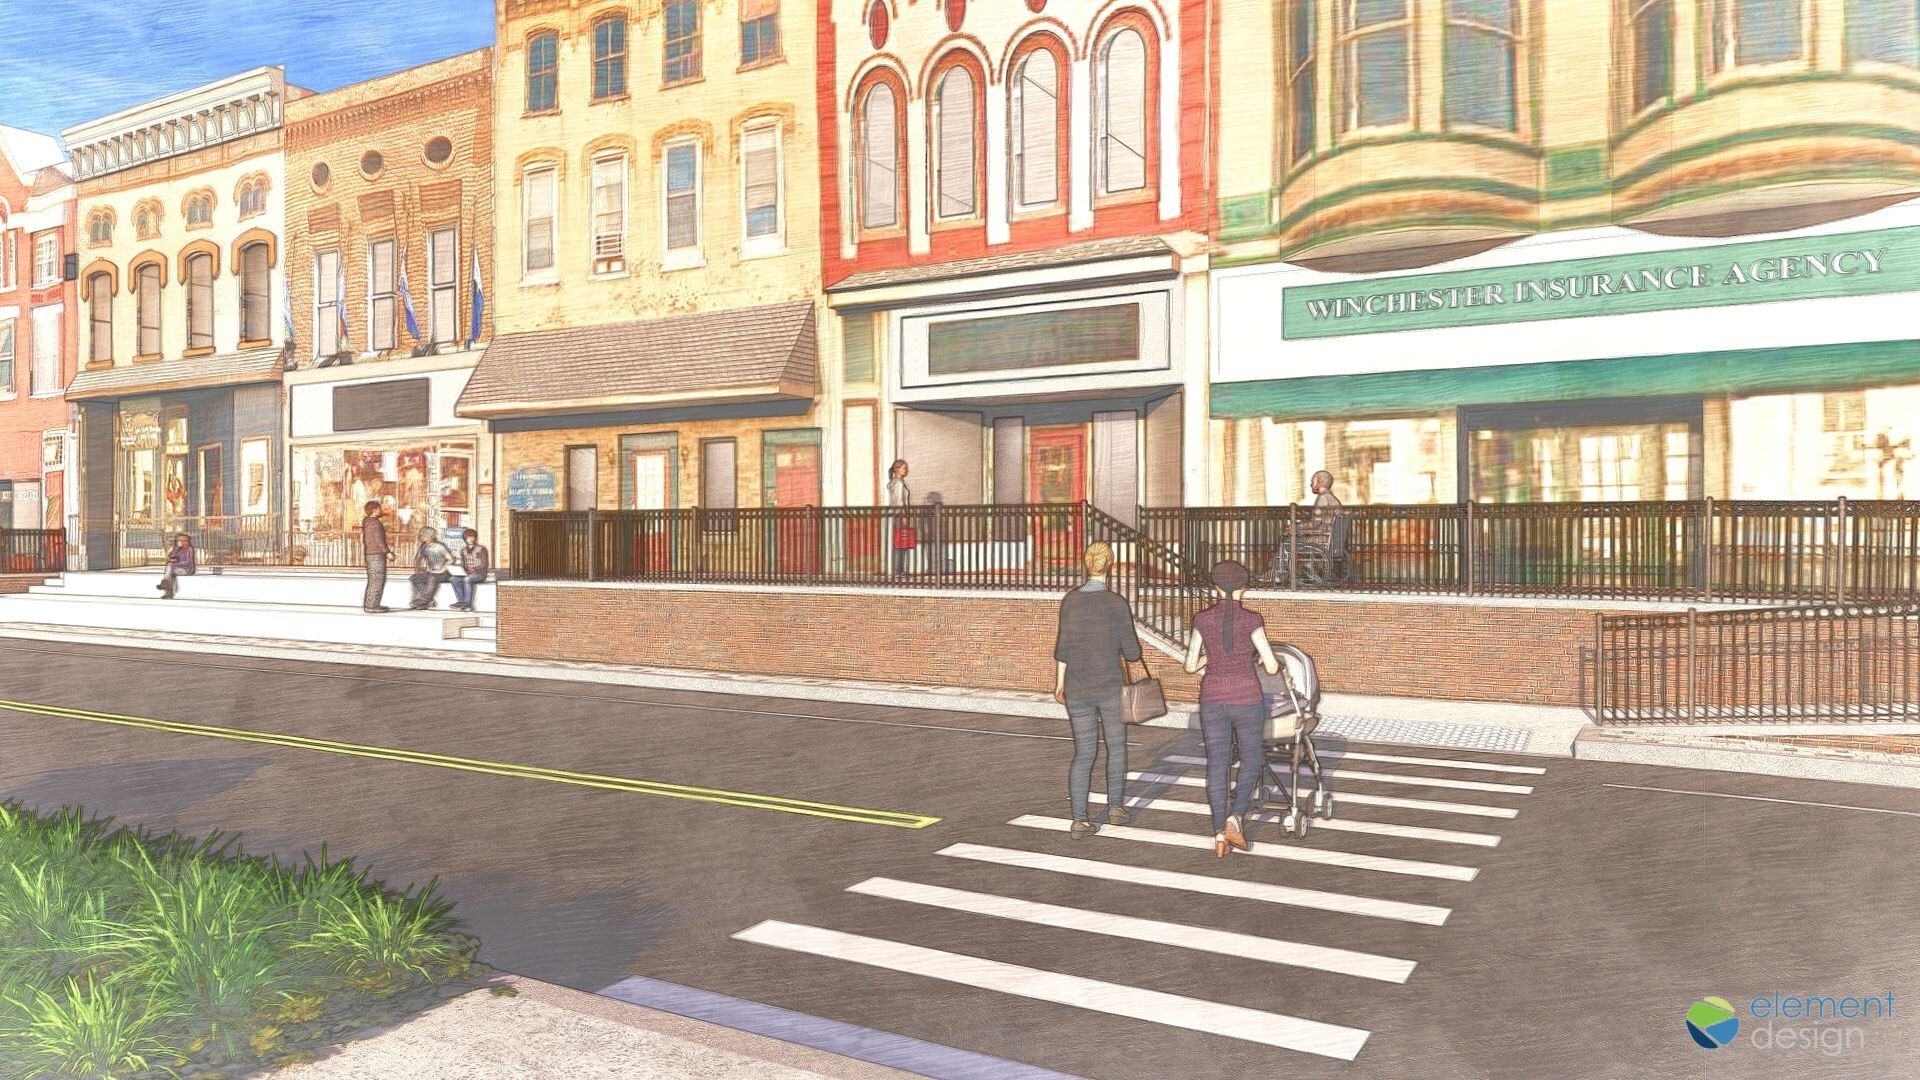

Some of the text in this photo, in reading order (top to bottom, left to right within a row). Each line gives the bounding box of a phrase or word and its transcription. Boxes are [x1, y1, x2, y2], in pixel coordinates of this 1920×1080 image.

[1307, 247, 1888, 320] WINCHESTER INSURANCE AGENCY
